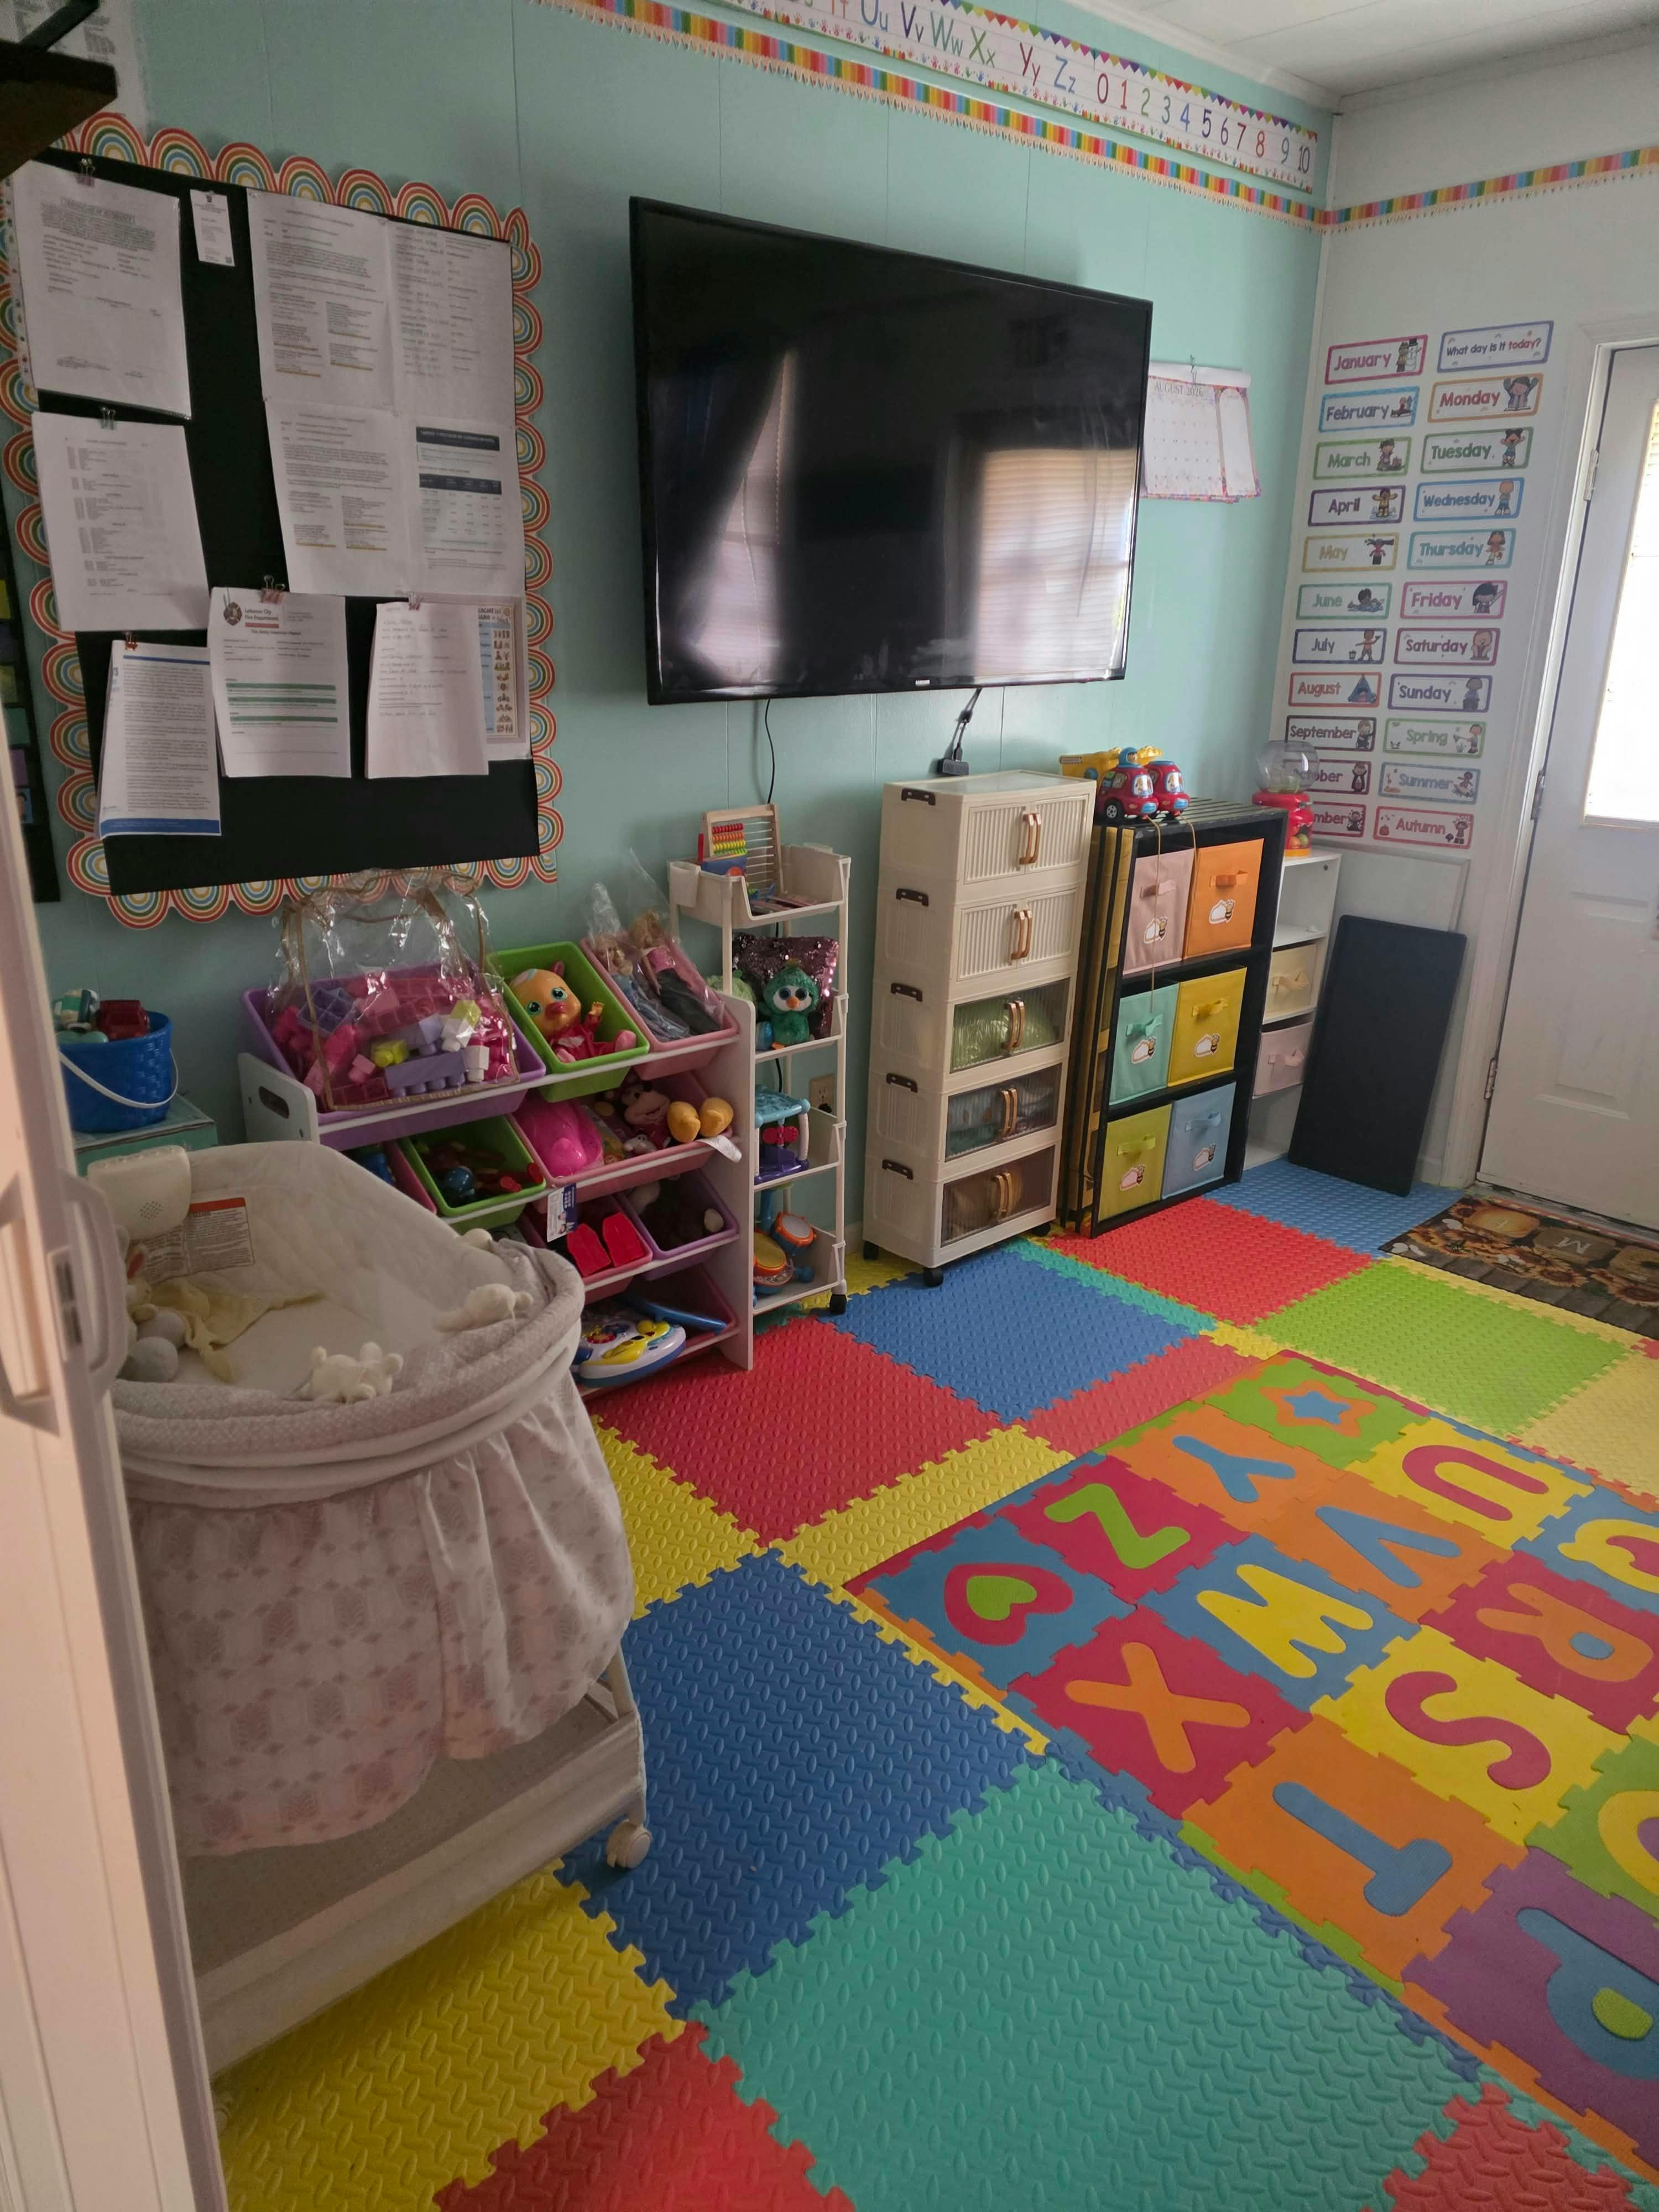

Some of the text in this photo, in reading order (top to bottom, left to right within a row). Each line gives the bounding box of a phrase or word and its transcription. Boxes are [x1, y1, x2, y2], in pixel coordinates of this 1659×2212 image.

[901, 1, 924, 43] Vv
[930, 11, 963, 56] Ww
[969, 26, 996, 68] Xx
[1019, 41, 1041, 86] Yy
[1053, 55, 1076, 93] Zz
[1097, 73, 1109, 104] 0
[1120, 79, 1128, 109] 1
[1141, 87, 1151, 117] 2
[1161, 95, 1171, 124] 3
[1180, 102, 1191, 132] 4
[1202, 108, 1212, 138] 5
[1220, 117, 1229, 145] 6
[1237, 122, 1247, 150] 7
[1255, 130, 1265, 158] 8
[1281, 137, 1290, 164] 9
[1297, 145, 1311, 174] 10
[1447, 346, 1469, 357] What
[1470, 343, 1488, 354] day
[1499, 341, 1506, 351] it
[1508, 337, 1542, 350] today?
[1334, 352, 1391, 371] January
[1439, 390, 1500, 408] Monday
[1326, 404, 1390, 422] February
[1328, 452, 1370, 468] March
[1431, 443, 1492, 460] Tuesday
[1328, 498, 1360, 515] April
[1423, 493, 1496, 508] Wednesday
[1319, 546, 1349, 560] May
[1420, 541, 1484, 558] Thursday
[1312, 594, 1343, 608] June
[1411, 592, 1463, 610] Friday
[1311, 638, 1335, 654] July
[1405, 639, 1468, 655] Saturday
[1297, 682, 1342, 697] August
[1399, 685, 1452, 703] Sunday
[1290, 726, 1357, 742] September
[1406, 728, 1448, 747] Spring
[1399, 773, 1453, 789] Summer
[1395, 817, 1447, 836] Autumn
[1172, 1434, 1296, 1503] Y
[1402, 1444, 1549, 1521] U
[1044, 1483, 1191, 1569] Z
[1314, 1505, 1462, 1588] V
[1196, 1563, 1375, 1678] W
[1475, 1582, 1654, 1682] R
[1065, 1642, 1251, 1773] X
[1385, 1671, 1551, 1790] S
[1272, 1781, 1453, 1917] T
